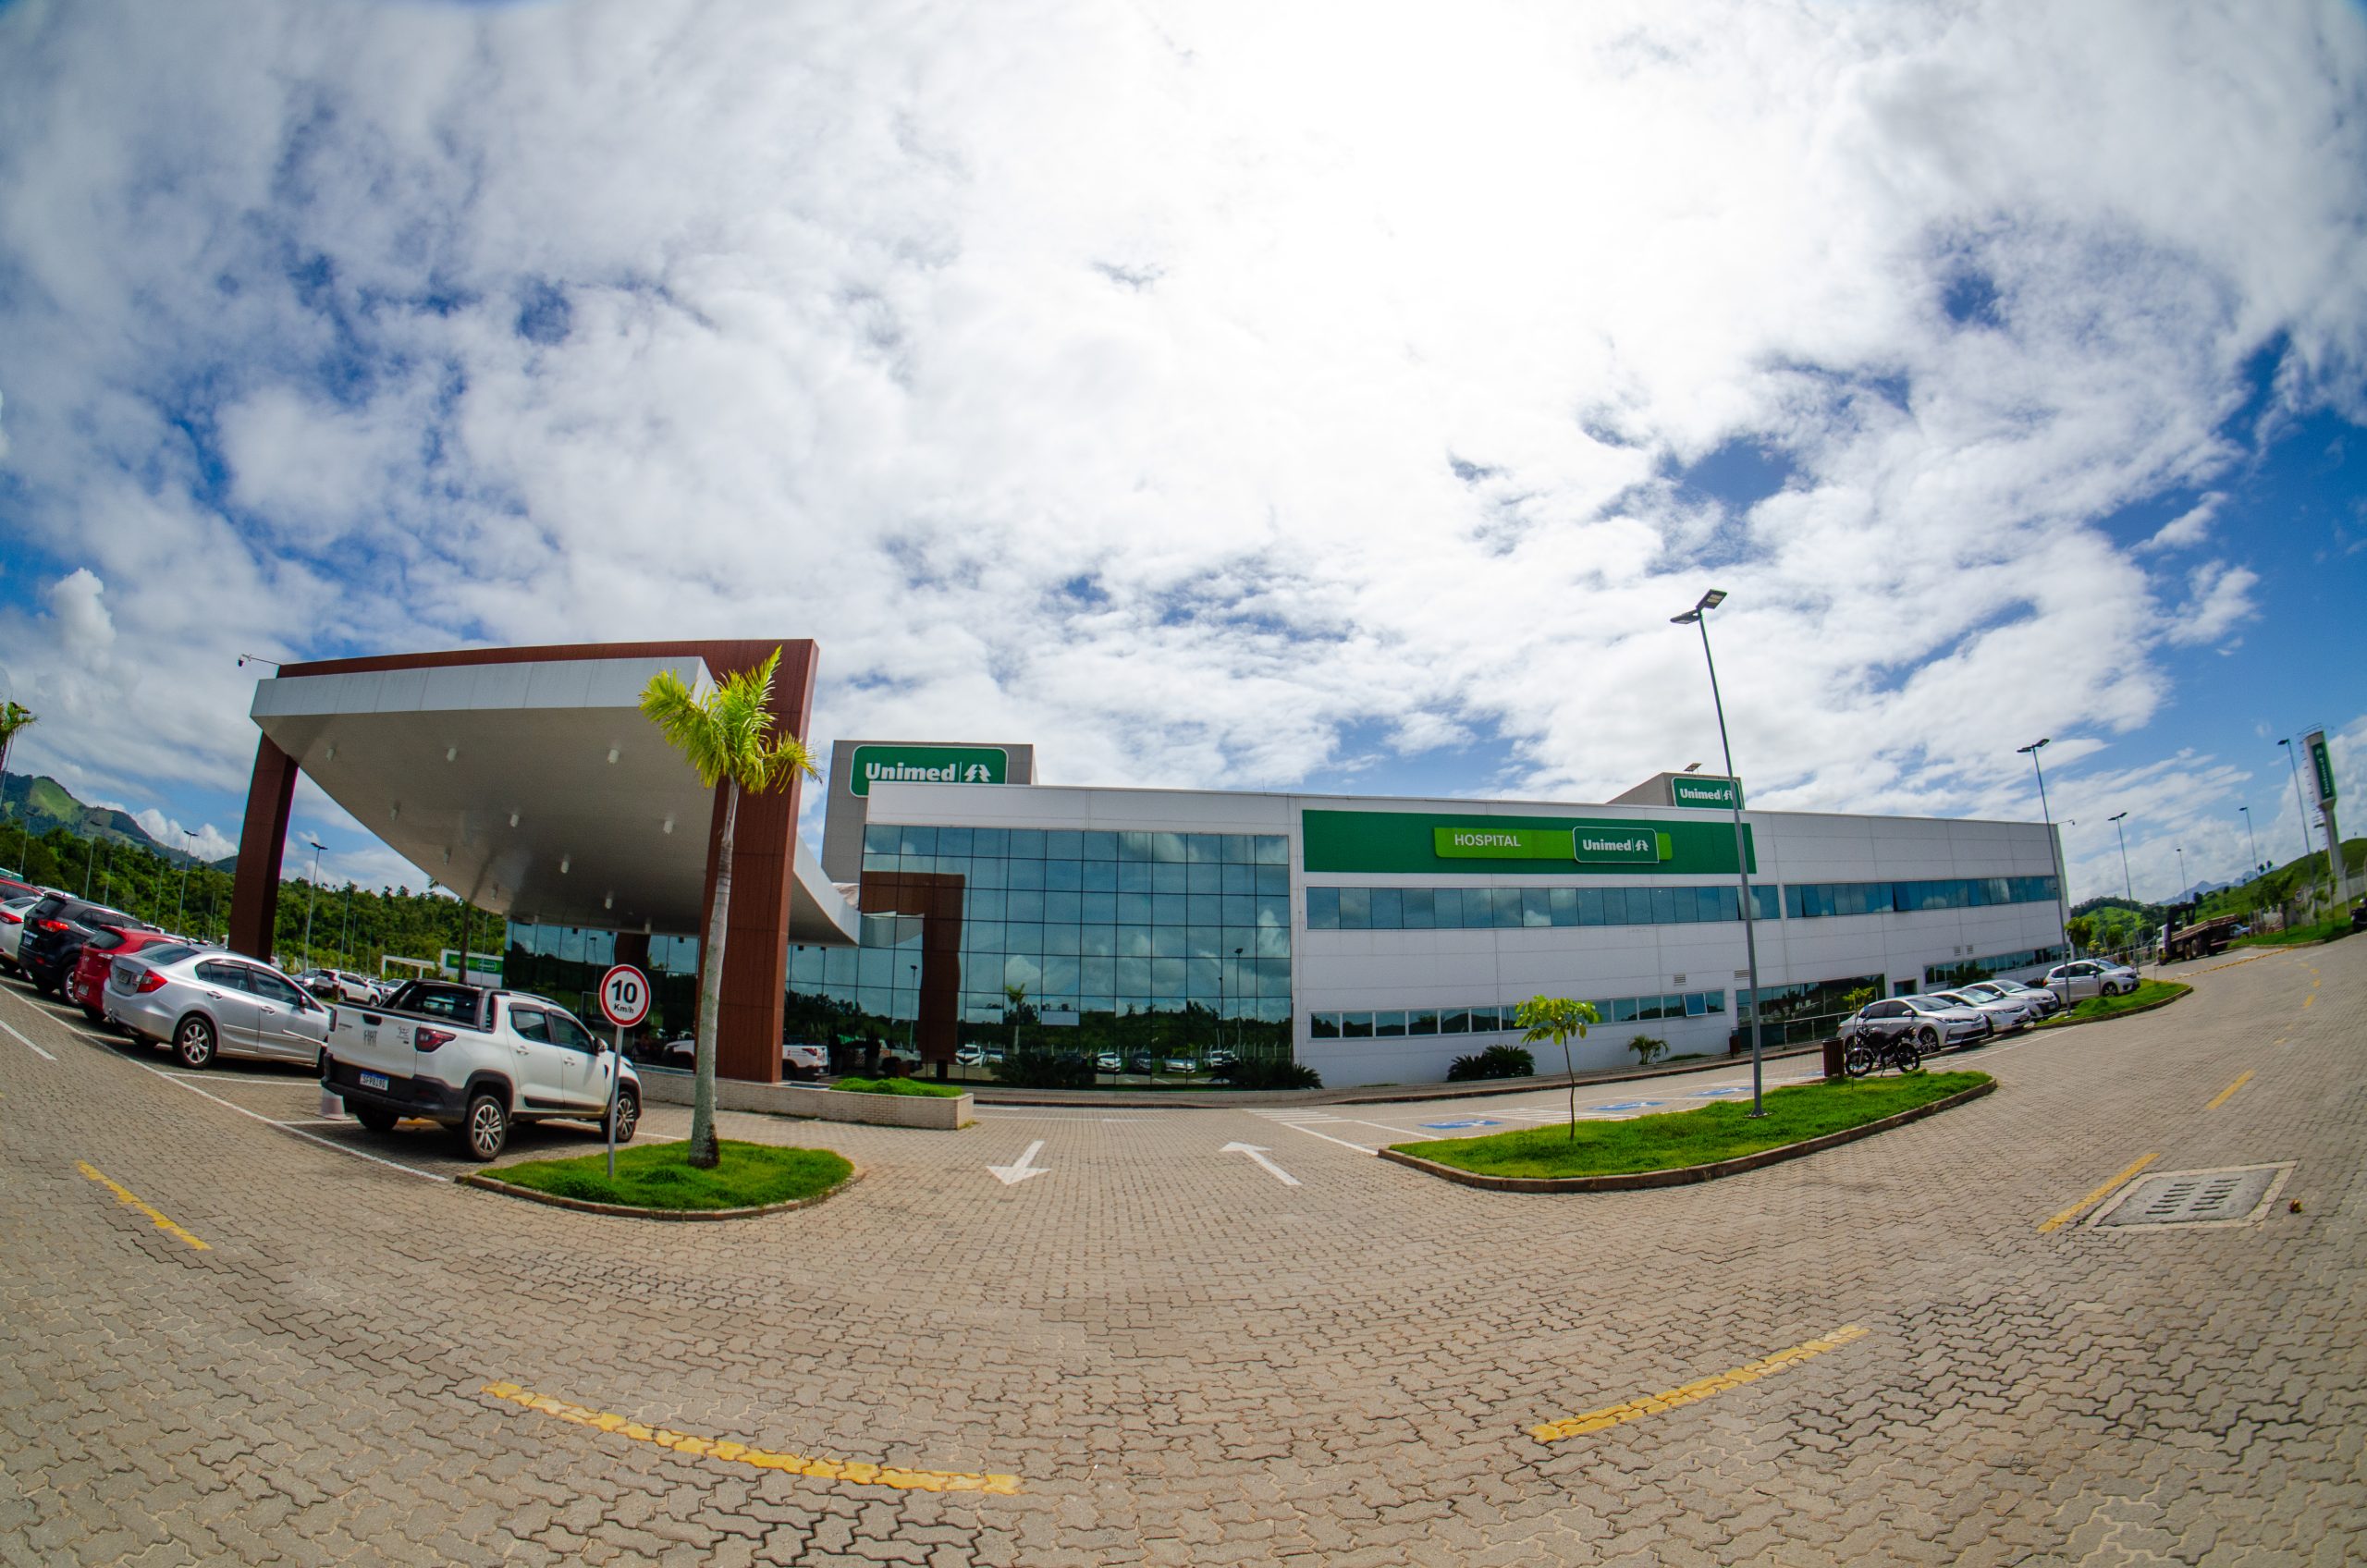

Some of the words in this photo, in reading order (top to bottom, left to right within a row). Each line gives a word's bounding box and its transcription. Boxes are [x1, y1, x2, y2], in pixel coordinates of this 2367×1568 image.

[865, 762, 957, 782] Unimed
[1679, 788, 1722, 801] Unimed
[1454, 834, 1522, 847] HOSPITAL
[1582, 838, 1632, 851] Unimed
[611, 979, 638, 1004] 10
[614, 1003, 634, 1014] Km/h
